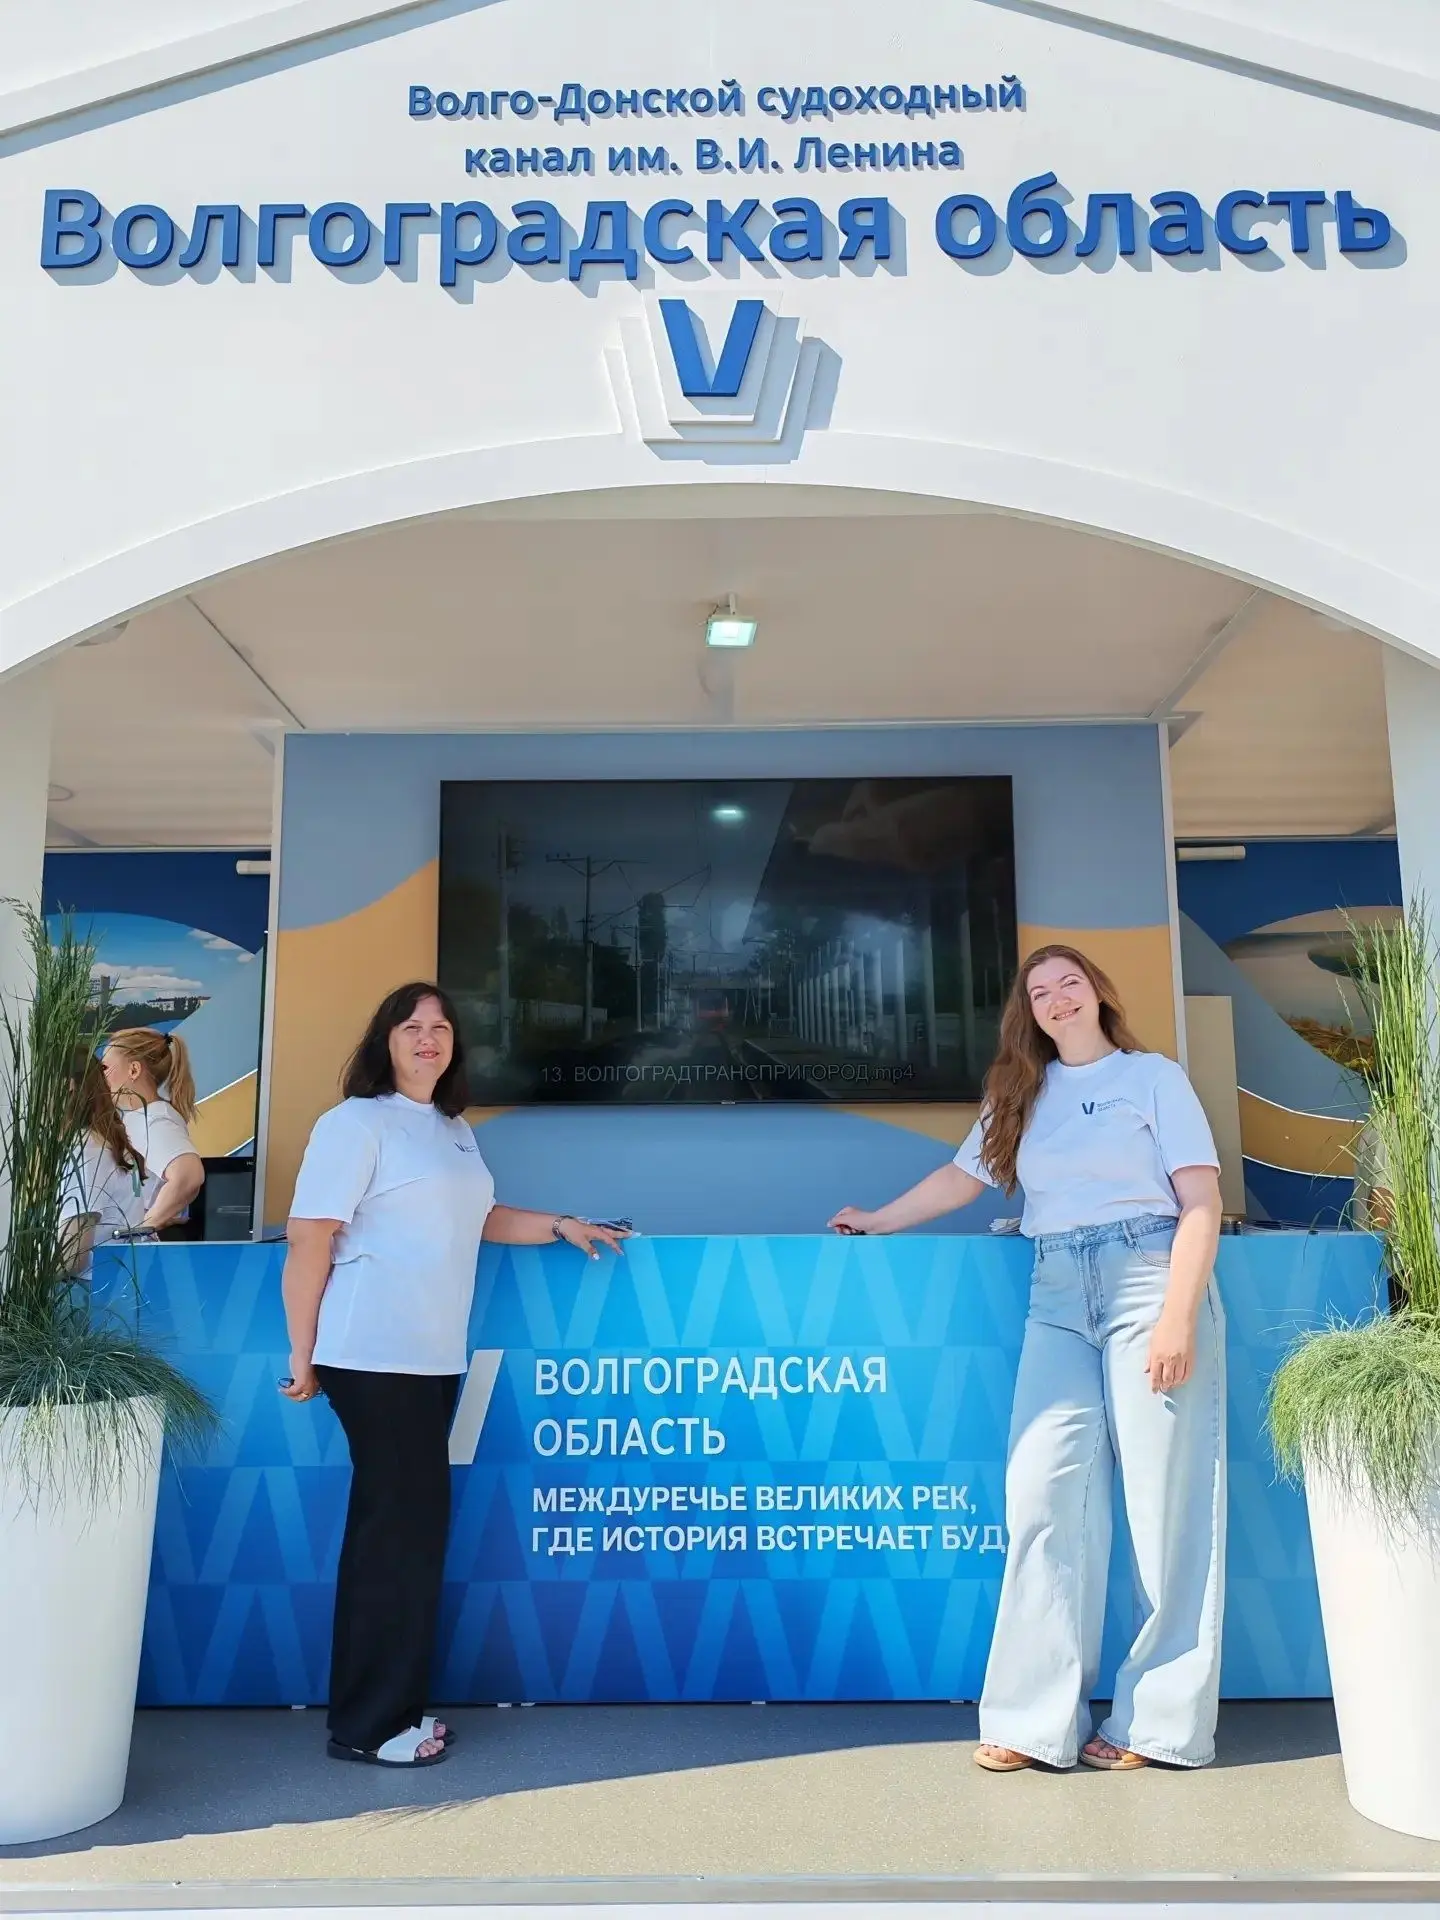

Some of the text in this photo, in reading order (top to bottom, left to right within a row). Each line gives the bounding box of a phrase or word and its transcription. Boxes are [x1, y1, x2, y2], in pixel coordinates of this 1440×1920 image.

[408, 75, 1022, 121] Волго-Донской судоходный
[465, 137, 960, 173] канал им. В.И. Ленина
[40, 171, 1391, 287] Волгоградская область
[540, 1063, 915, 1084] 13. ВОЛГОГРАДТРАНСПРИГОРОД.mp4
[534, 1356, 887, 1400] ВОЛГОГРАДСКАЯ
[533, 1417, 727, 1457] ОБЛАСТЬ
[532, 1485, 977, 1516] МЕЖДУРЕЧЬЕ ВЕЛИКИХ РЕК,
[532, 1525, 1007, 1555] ГДЕ ИСТОРИЯ ВСТРЕЧАЕТ БУД
